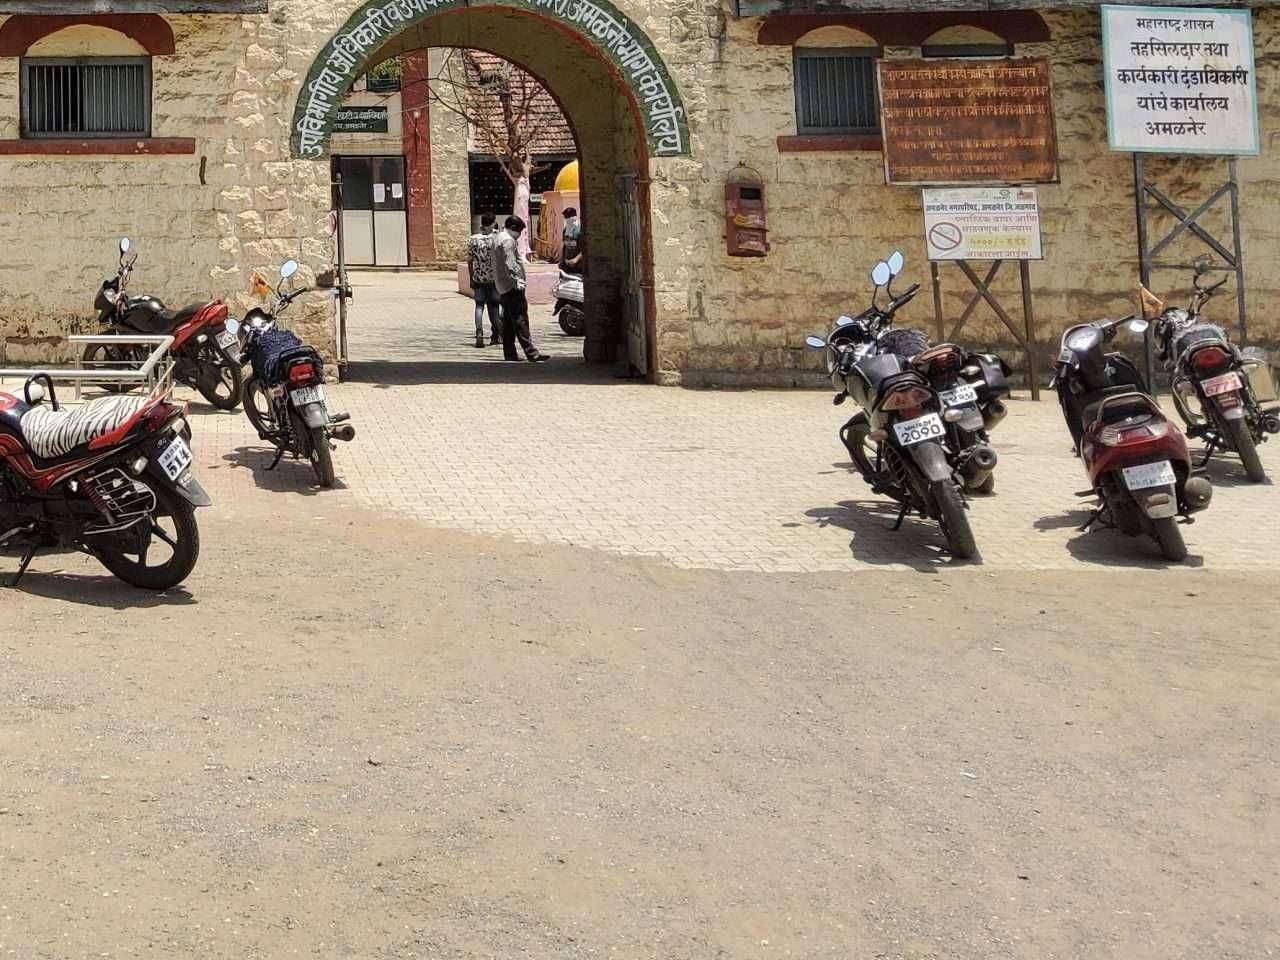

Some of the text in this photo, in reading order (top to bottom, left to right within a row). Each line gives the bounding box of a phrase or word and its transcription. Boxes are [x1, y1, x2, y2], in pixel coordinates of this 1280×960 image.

[1136, 18, 1214, 32] महाराष्ट्र शासन
[1130, 37, 1229, 60] तहसिलदार तथा
[1117, 64, 1248, 88] कार्यकारी दंडाधिकारी
[1136, 91, 1229, 111] यांचे कार्यालय
[1145, 116, 1207, 135] अमळनेर
[901, 424, 941, 443] 2090
